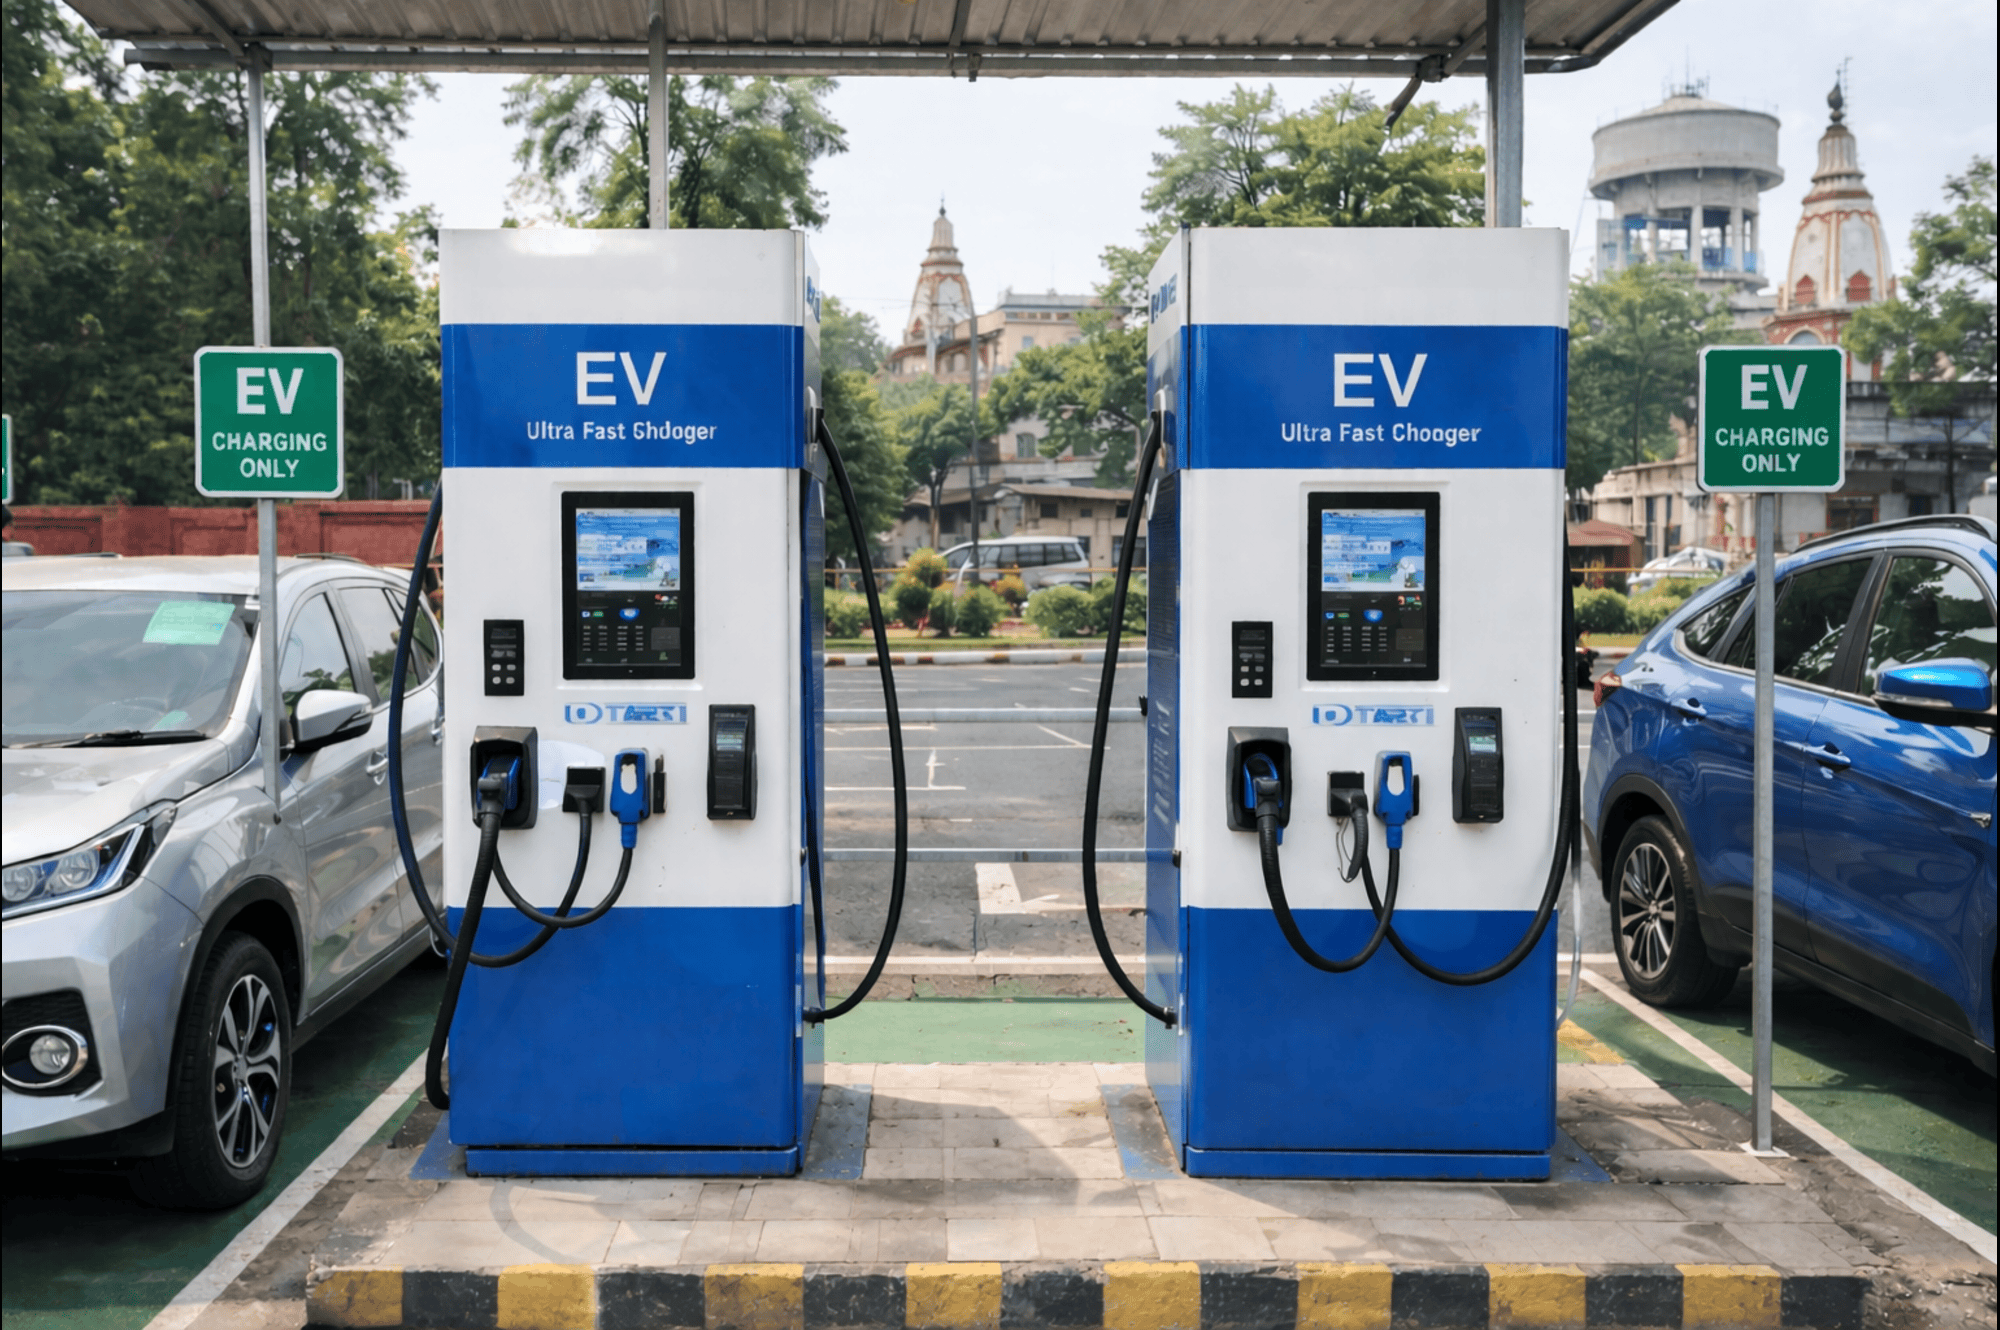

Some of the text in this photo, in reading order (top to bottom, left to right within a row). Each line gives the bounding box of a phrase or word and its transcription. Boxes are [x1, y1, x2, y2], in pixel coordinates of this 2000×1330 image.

[577, 352, 667, 405] EV
[1333, 353, 1428, 407] EV
[1741, 364, 1808, 410] EV
[236, 367, 304, 415] EV
[527, 421, 575, 440] Ultra
[583, 421, 626, 440] Fast
[1281, 422, 1332, 442] Ultra
[1339, 423, 1385, 442] Fast
[1715, 427, 1829, 447] CHARGING
[212, 431, 327, 451] CHARGING
[240, 457, 300, 478] ONLY
[1742, 453, 1801, 473] ONLY
